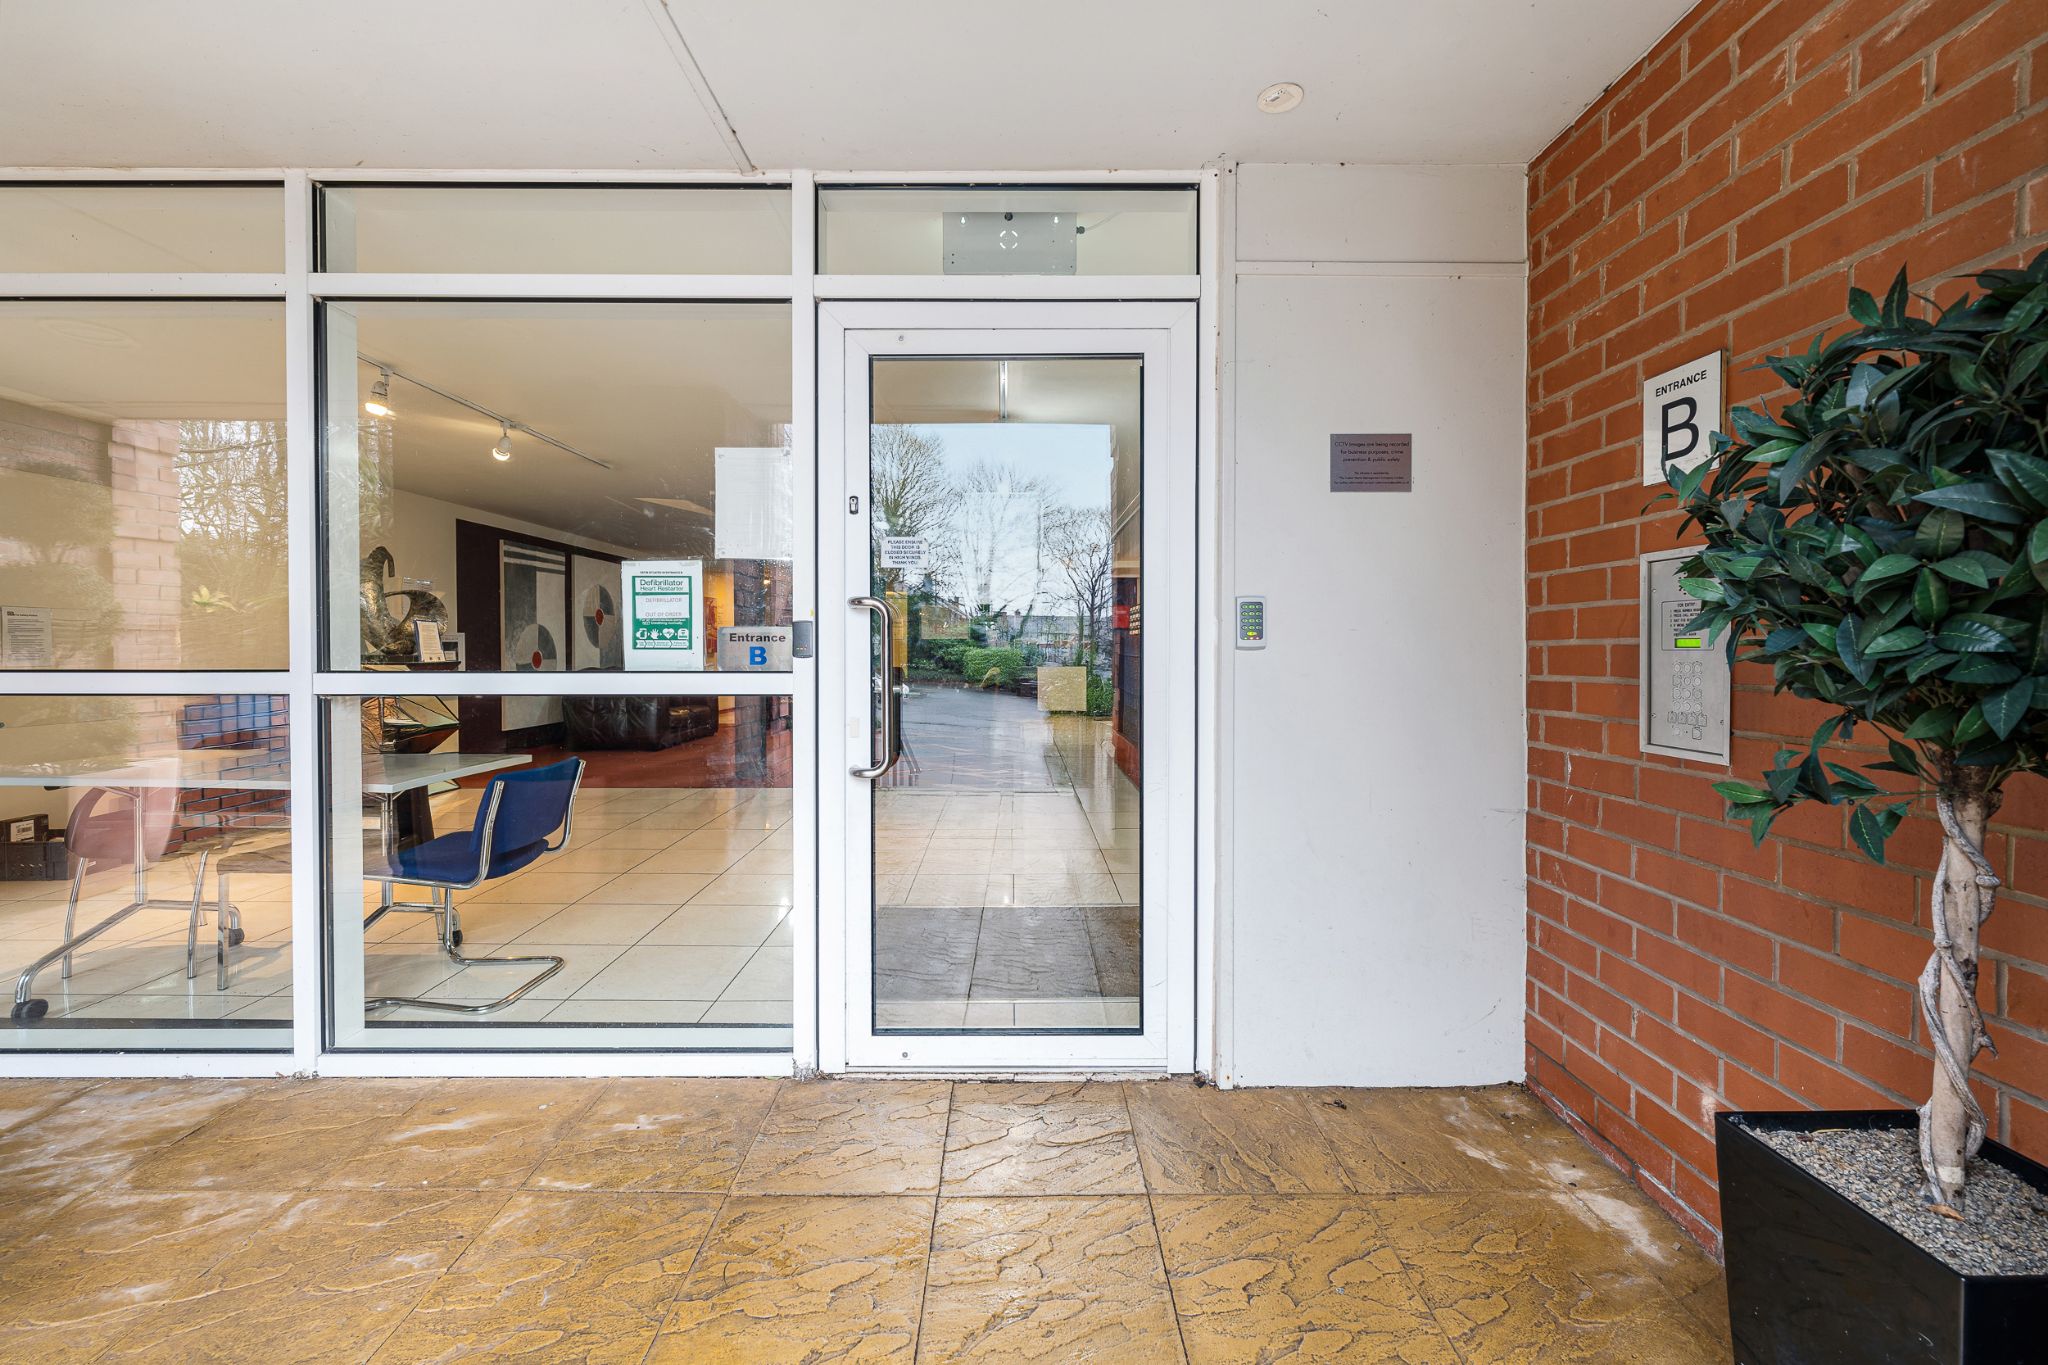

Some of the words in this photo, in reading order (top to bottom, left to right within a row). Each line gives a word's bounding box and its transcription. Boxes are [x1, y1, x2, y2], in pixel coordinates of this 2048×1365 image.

[1655, 370, 1708, 397] ENTRANCE
[1661, 397, 1700, 462] B
[639, 578, 684, 586] Defibrillator
[729, 633, 786, 642] Entrance
[749, 646, 767, 665] B
